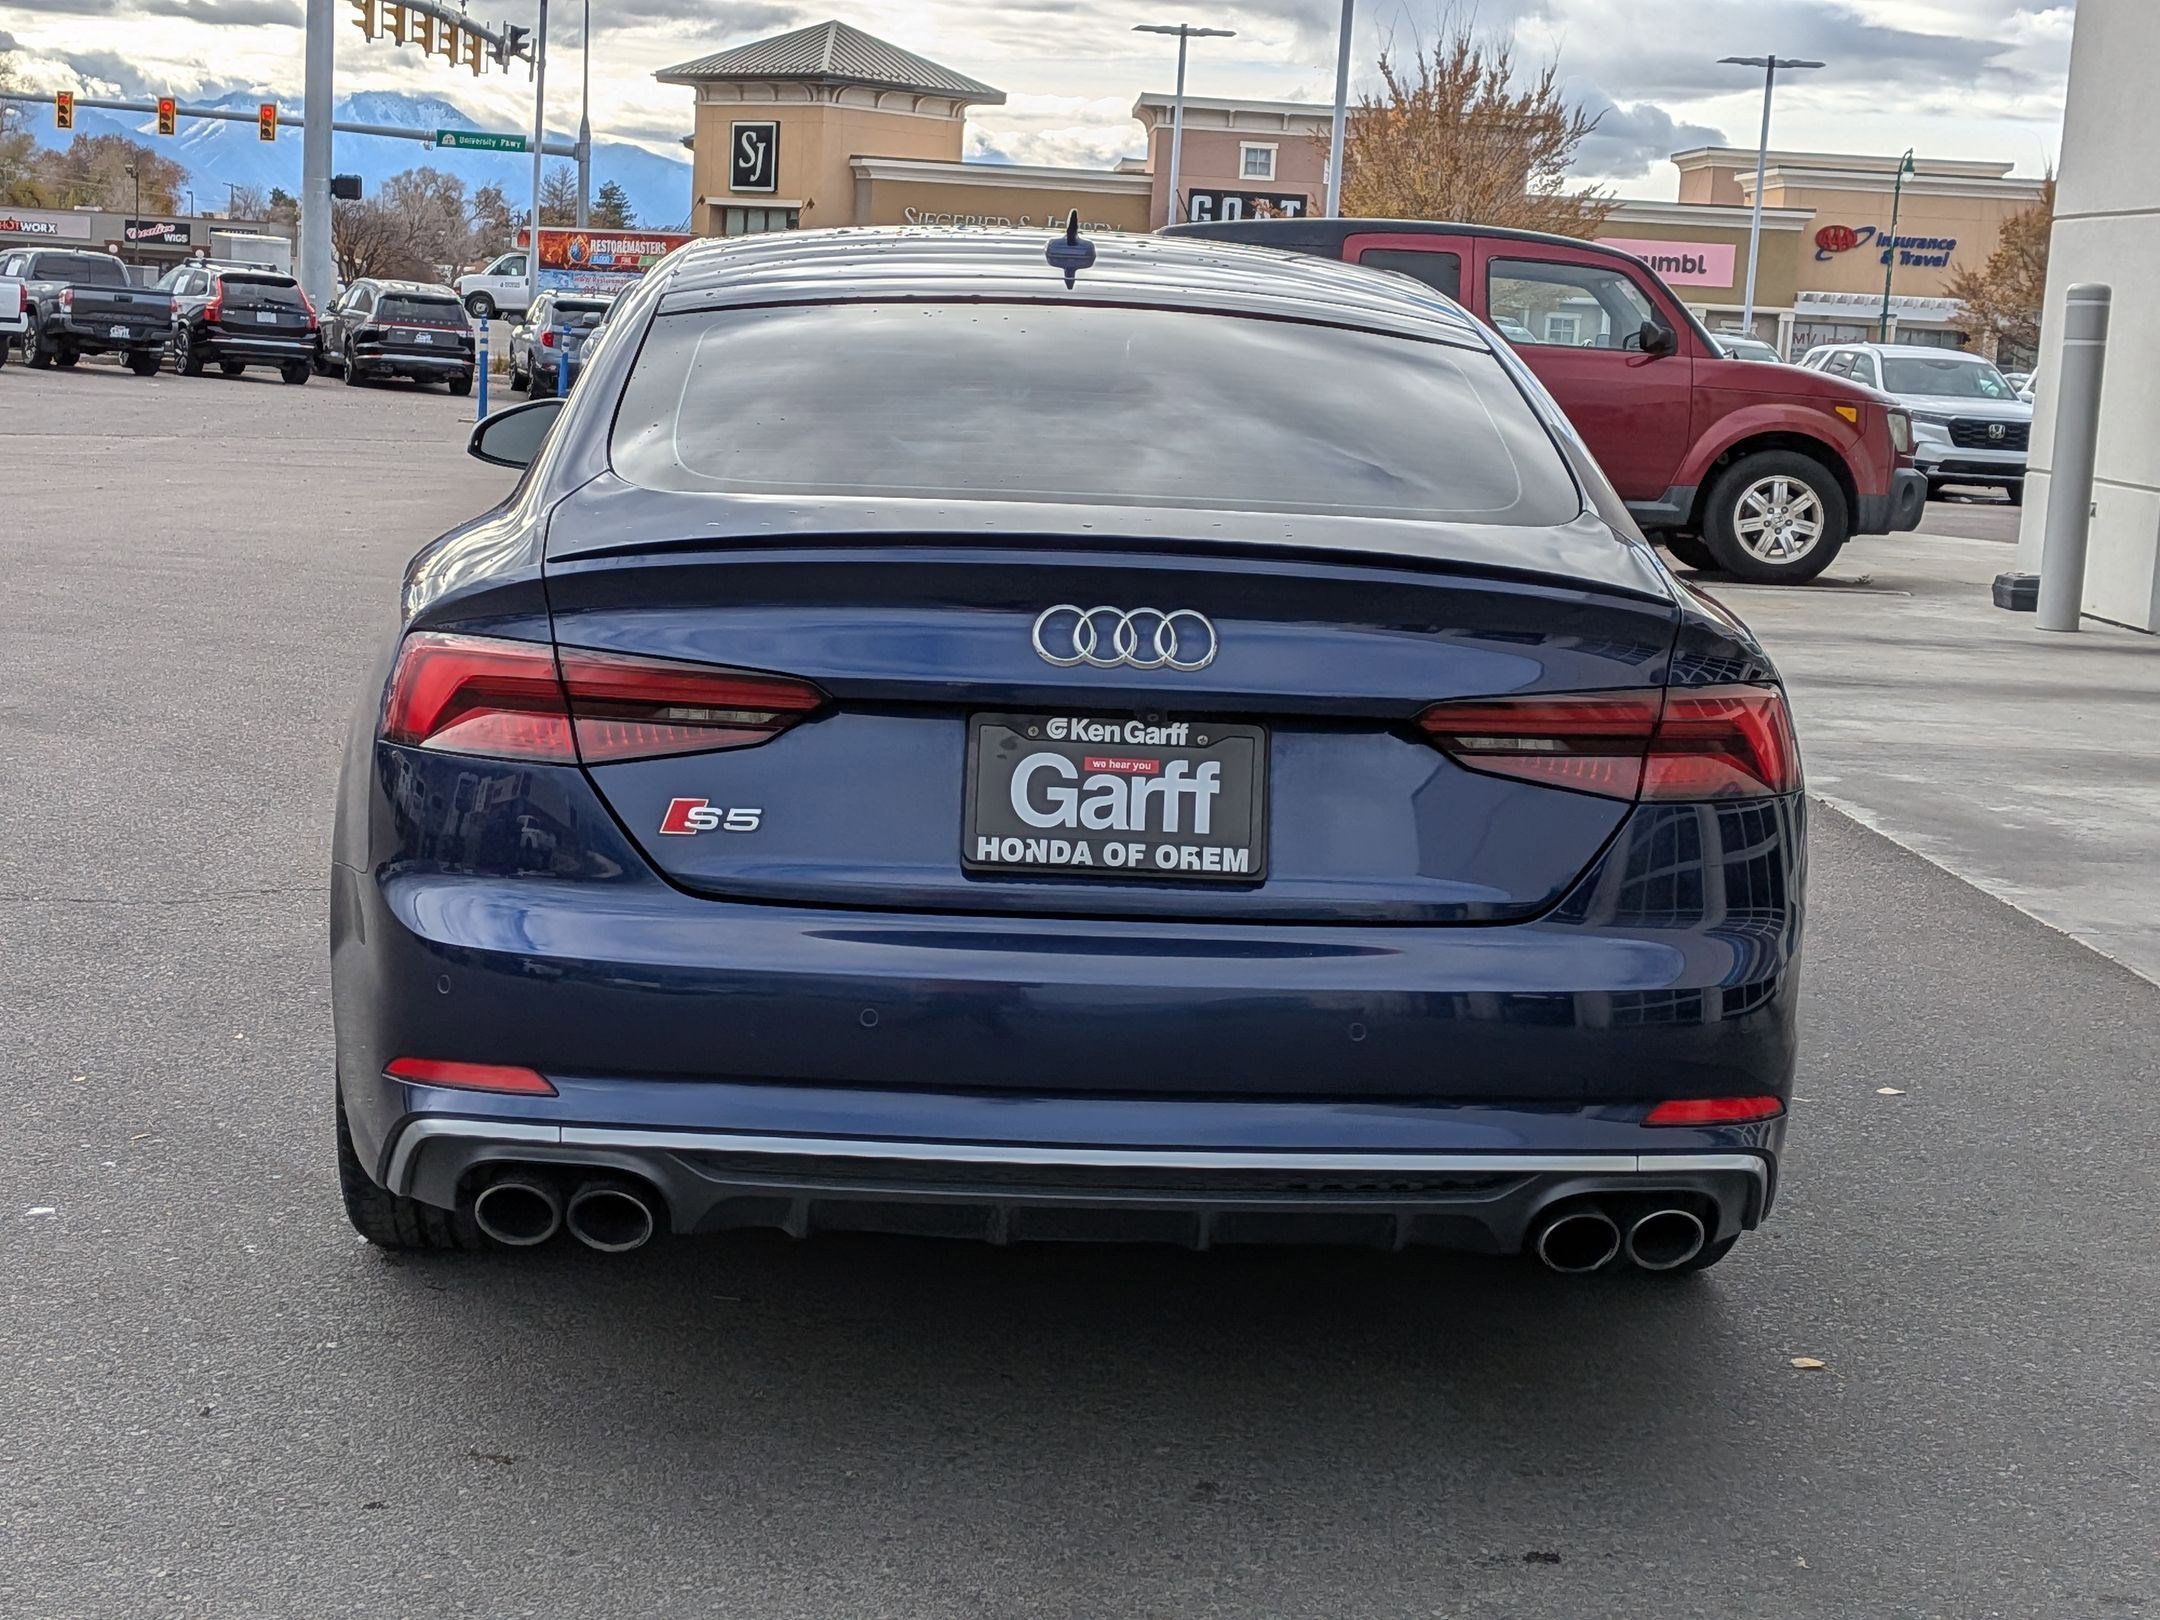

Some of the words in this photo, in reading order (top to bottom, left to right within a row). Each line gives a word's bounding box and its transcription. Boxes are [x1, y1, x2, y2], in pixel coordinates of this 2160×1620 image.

[459, 136, 497, 148] University
[164, 233, 188, 243] WIGS
[590, 239, 667, 254] RESTOREMASTERS
[1876, 232, 1957, 251] Insurance
[1636, 254, 1707, 275] umbl
[1900, 252, 1949, 267] Travel
[1070, 718, 1120, 742] Ken
[1123, 720, 1189, 745] Garff
[1092, 760, 1107, 768] we
[1109, 759, 1130, 769] hear
[1132, 762, 1152, 774] you
[1010, 752, 1221, 835] Garff
[684, 806, 762, 831] S5
[976, 837, 1092, 867] HONDA
[1103, 842, 1147, 868] OF
[1155, 845, 1249, 873] OREM
